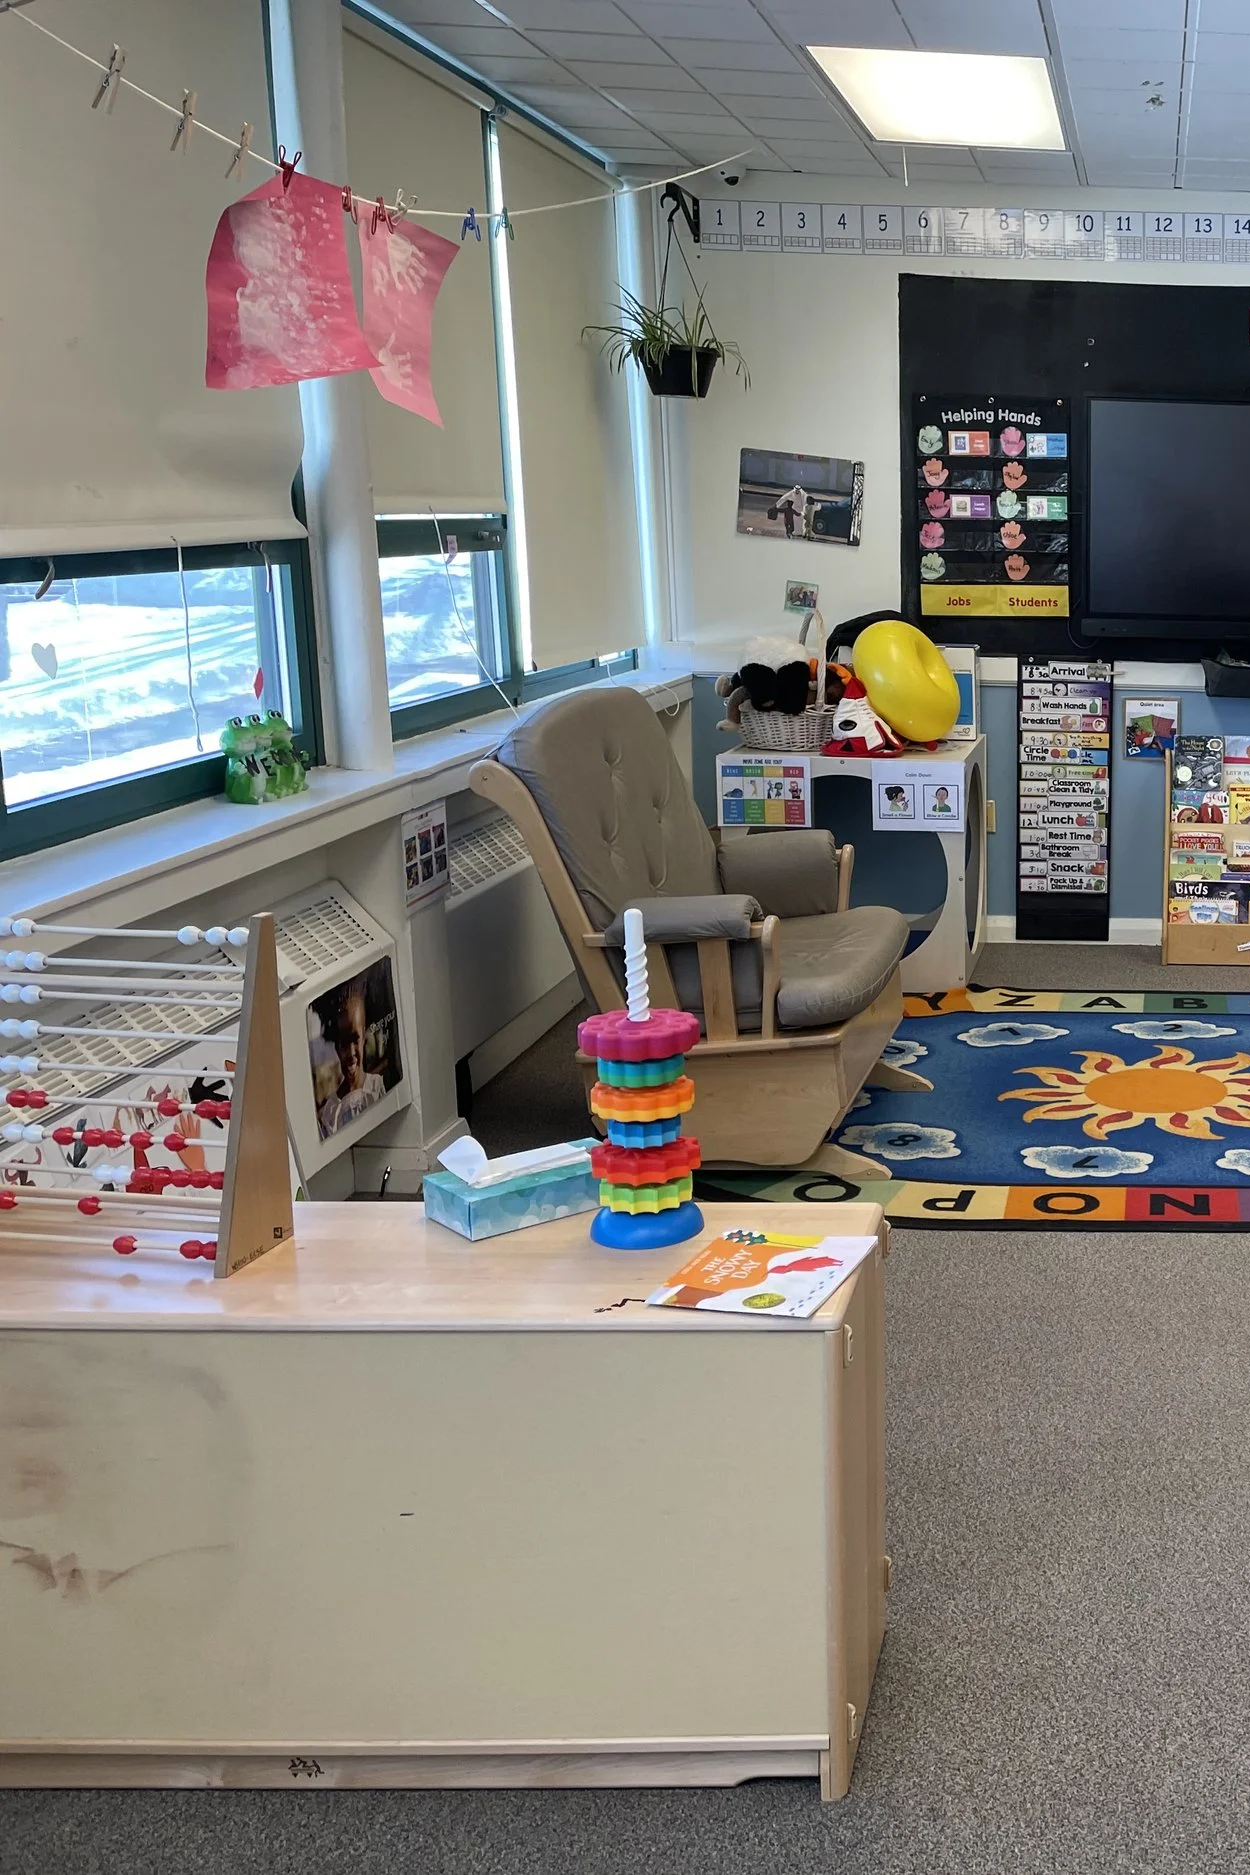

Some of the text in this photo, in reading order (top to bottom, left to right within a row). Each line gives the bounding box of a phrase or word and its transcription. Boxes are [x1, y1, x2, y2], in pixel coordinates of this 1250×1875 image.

[715, 208, 723, 226] 1
[756, 211, 765, 228] 2
[797, 212, 806, 229] 3
[837, 213, 847, 230] 4
[878, 214, 888, 232] 5
[918, 212, 929, 229] 6
[958, 211, 970, 230] 7
[999, 213, 1009, 230] 8
[1039, 214, 1049, 232] 9
[1075, 214, 1094, 232] 10
[1116, 216, 1132, 231] 11
[1155, 217, 1173, 233] 12
[1194, 218, 1213, 233] 13
[941, 408, 1042, 426] Helping Hands
[946, 597, 1059, 607] Jobs Students
[1051, 667, 1085, 676] Arrival
[1042, 701, 1087, 710] Wash Hands
[1022, 717, 1061, 725] Breakfast
[1023, 746, 1049, 754] Circle
[1049, 800, 1092, 808] Playground
[1042, 815, 1074, 825] Lunch
[1048, 832, 1092, 840] Rest Time
[1050, 863, 1084, 873] Snack
[1175, 883, 1208, 894] Birds
[994, 995, 1036, 1008] Z
[1081, 996, 1126, 1009] A
[1172, 998, 1207, 1009] B
[998, 1027, 1021, 1037] 1
[1163, 1023, 1184, 1033] 2
[887, 1134, 921, 1147] 8
[1072, 1155, 1099, 1169] 7
[922, 1190, 974, 1212] P
[1033, 1192, 1100, 1214] O
[1149, 1194, 1212, 1215] N
[701, 1256, 726, 1272] THE
[704, 1249, 752, 1285] SNOWY
[730, 1259, 762, 1279] DAY
